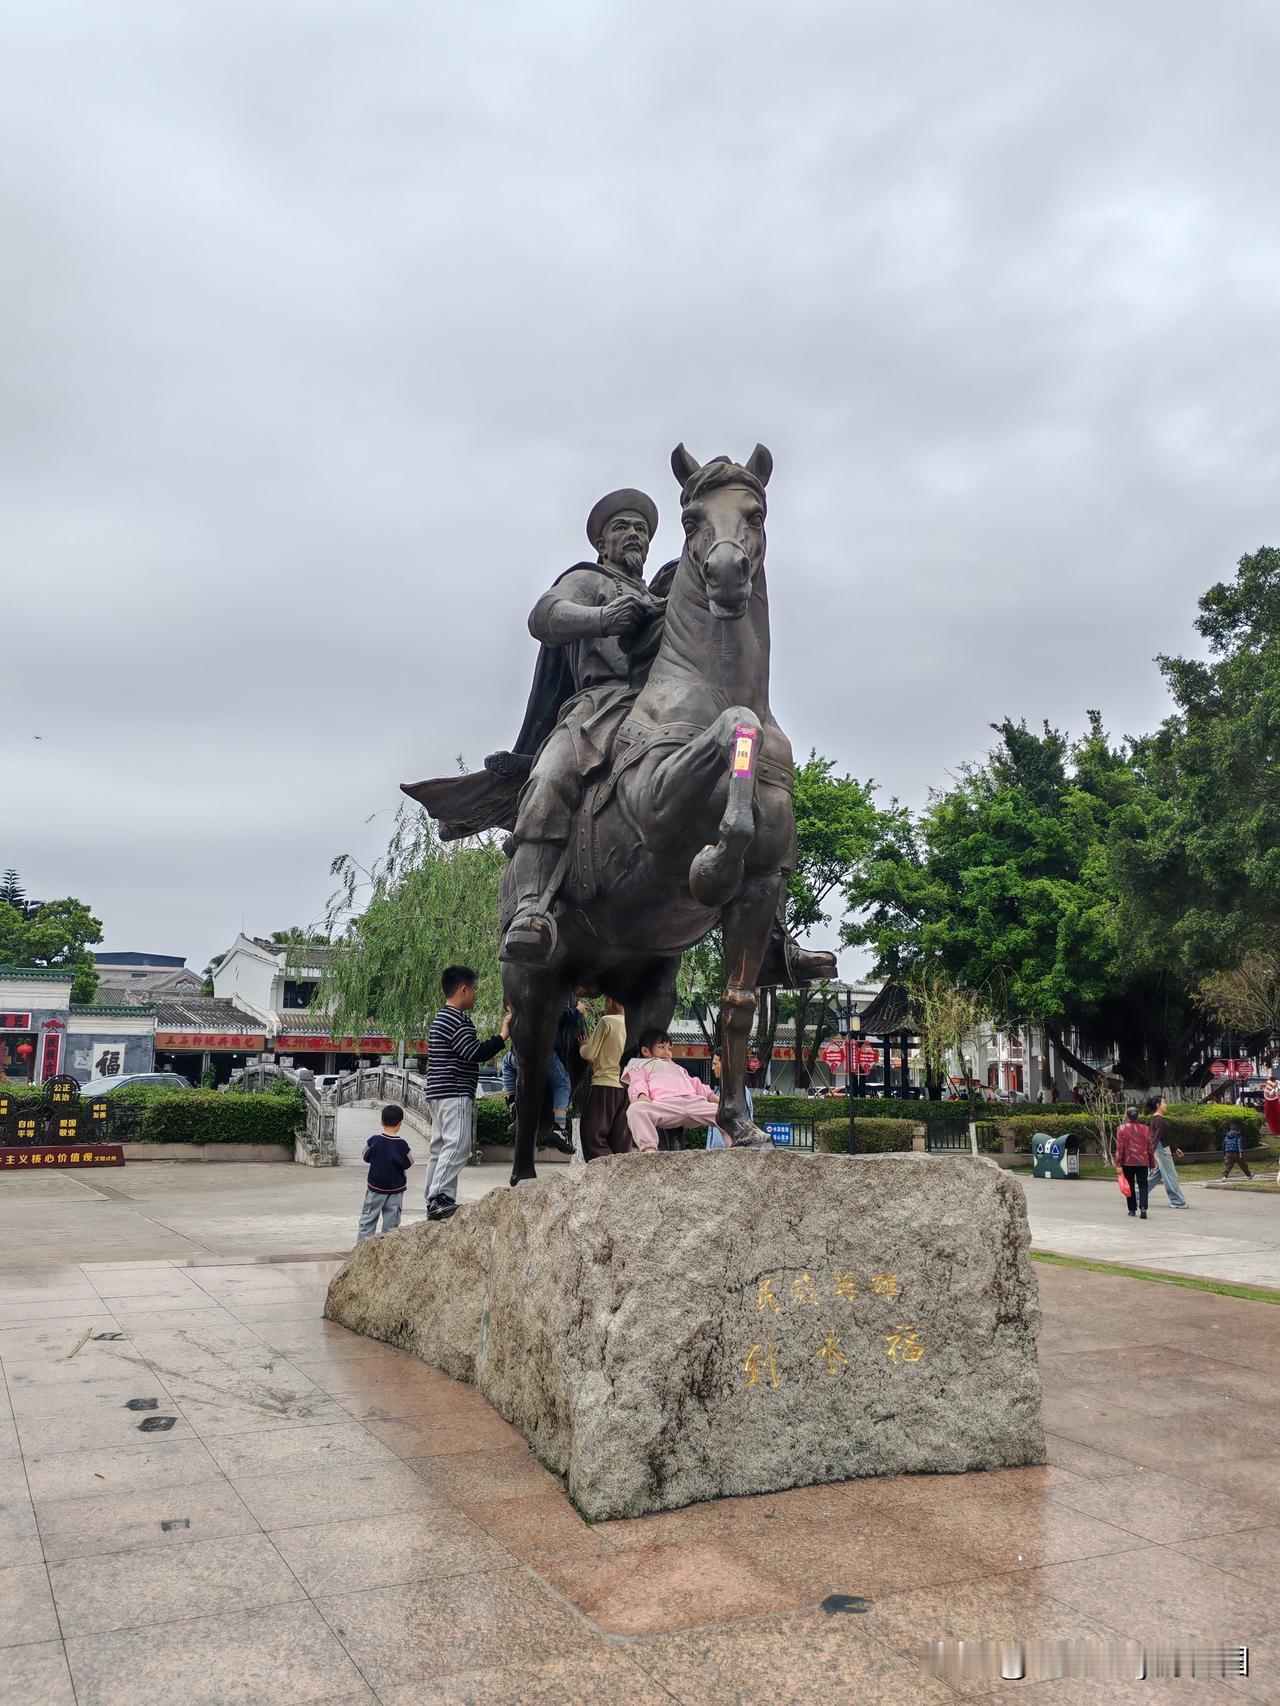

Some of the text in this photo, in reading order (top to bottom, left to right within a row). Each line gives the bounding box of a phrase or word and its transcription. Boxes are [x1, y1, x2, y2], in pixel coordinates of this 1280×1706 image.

[95, 1050, 120, 1076] 福
[53, 1084, 70, 1092] 公正
[52, 1093, 70, 1102] 法治
[18, 1120, 36, 1128] 自由
[59, 1119, 77, 1127] 爱国
[17, 1129, 36, 1138] 平等
[59, 1129, 76, 1137] 敬业
[0, 1152, 93, 1166] 主义核心价值观
[755, 1269, 901, 1315] 民族英雄
